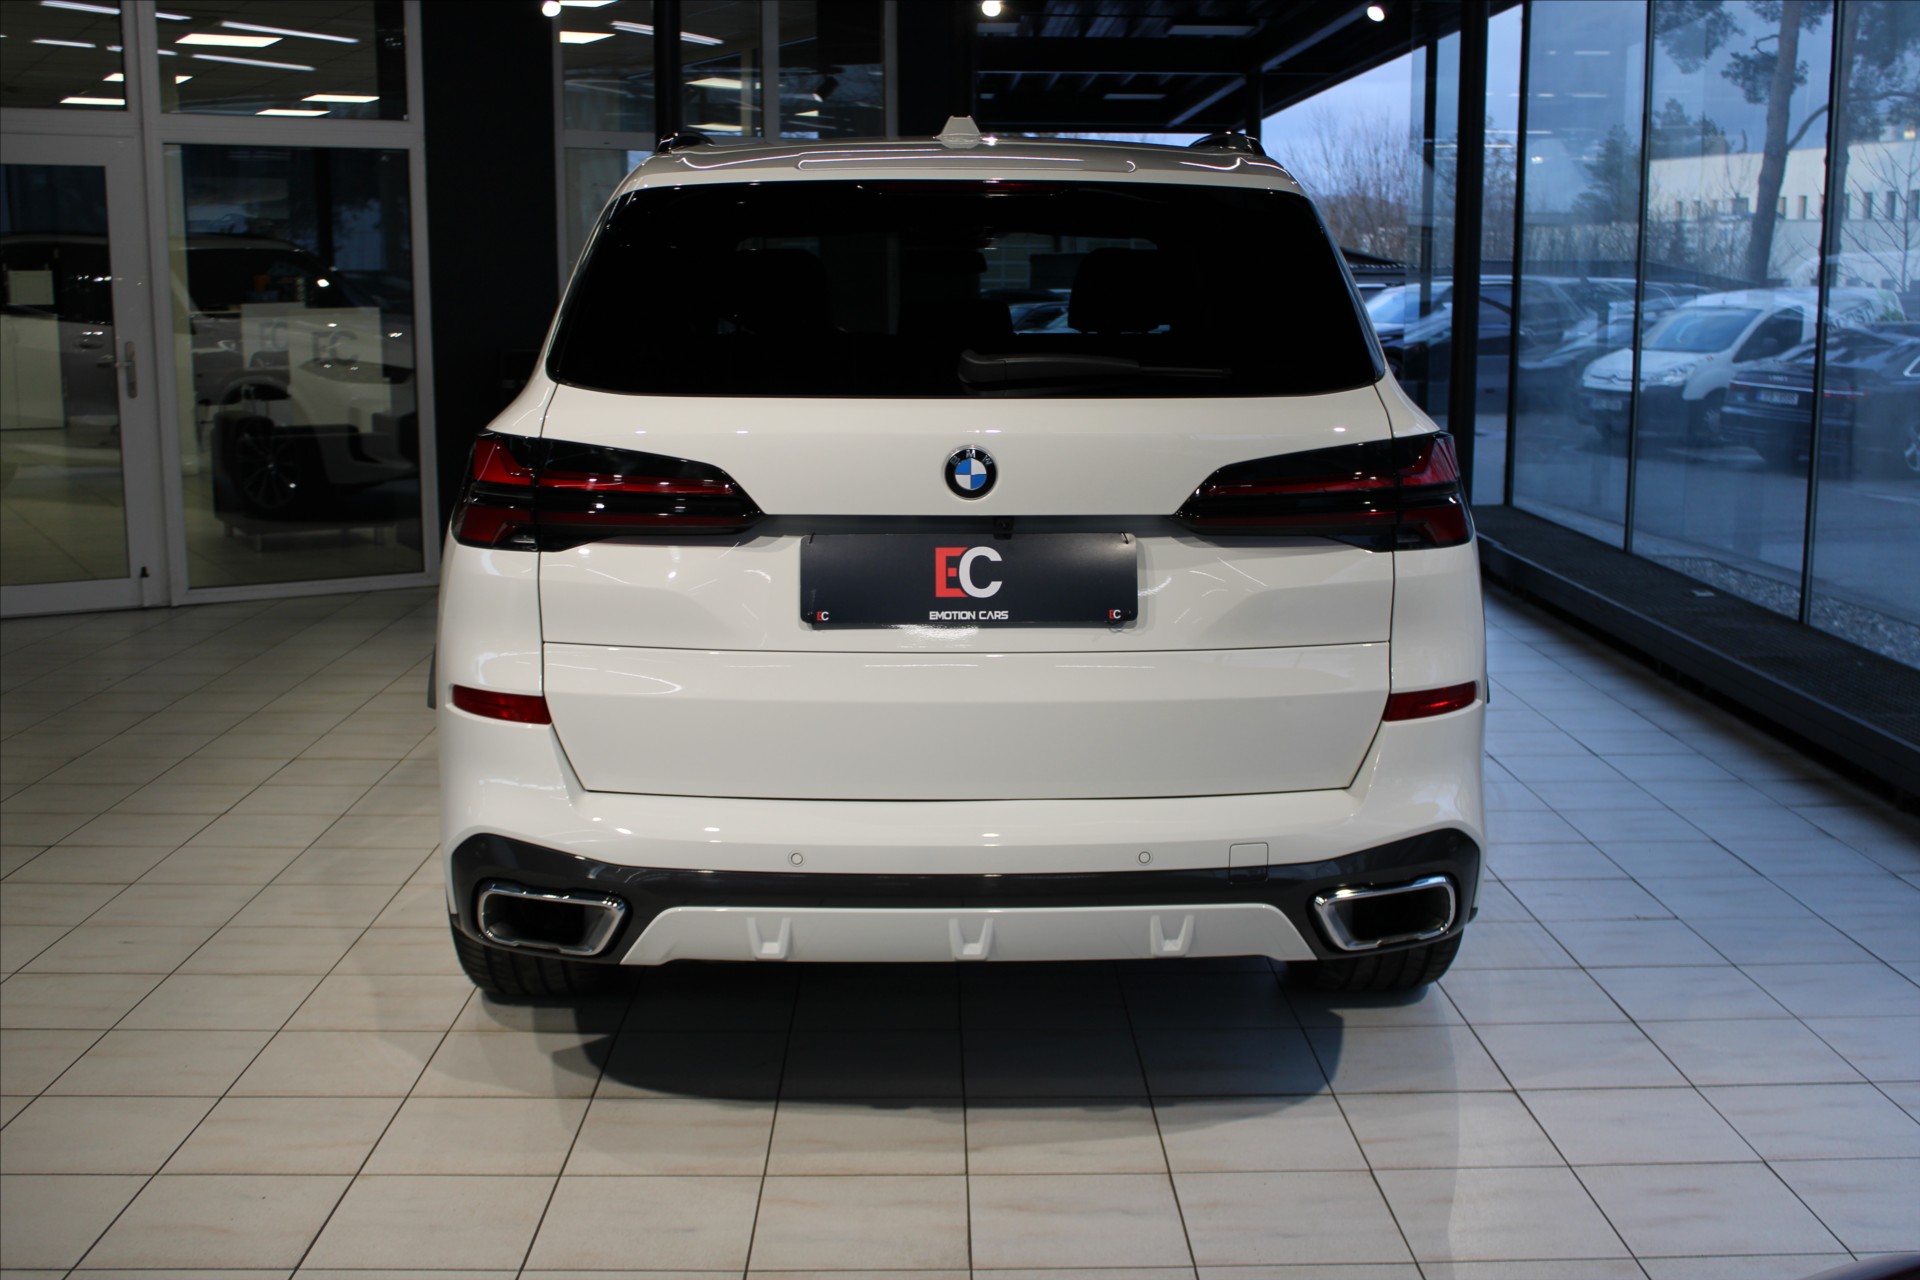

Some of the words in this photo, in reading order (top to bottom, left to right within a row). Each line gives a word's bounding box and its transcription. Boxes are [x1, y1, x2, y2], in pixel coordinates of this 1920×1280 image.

[949, 449, 993, 466] BMW
[935, 546, 1003, 598] EC
[816, 610, 829, 621] EC
[929, 611, 976, 620] EMOTION
[978, 611, 1009, 620] CARS
[1109, 609, 1121, 619] EC
